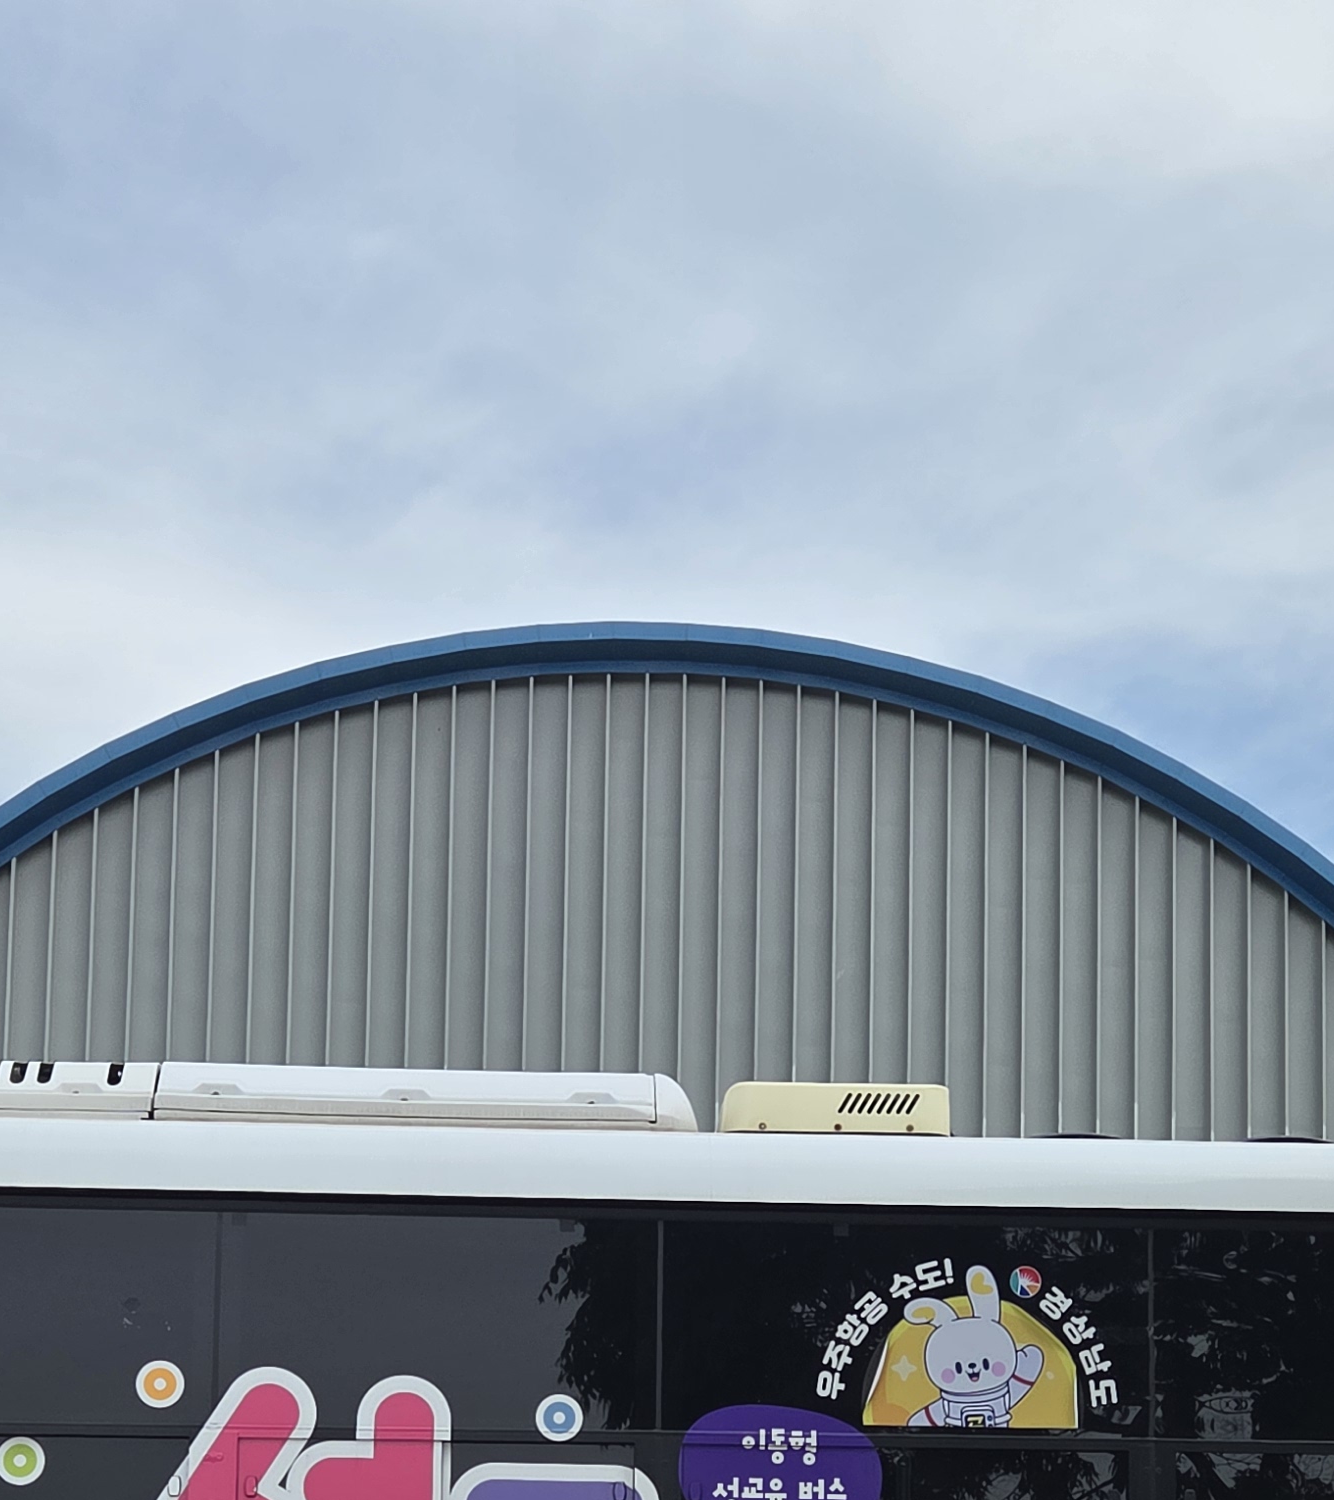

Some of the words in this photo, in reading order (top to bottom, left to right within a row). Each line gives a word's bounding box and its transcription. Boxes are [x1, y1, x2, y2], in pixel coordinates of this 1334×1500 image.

[816, 1291, 889, 1400] 우주항공
[889, 1257, 955, 1300] 수도!
[1039, 1286, 1118, 1408] 경상남도
[741, 1428, 817, 1466] 이동형
[798, 1477, 848, 1500] 버스
